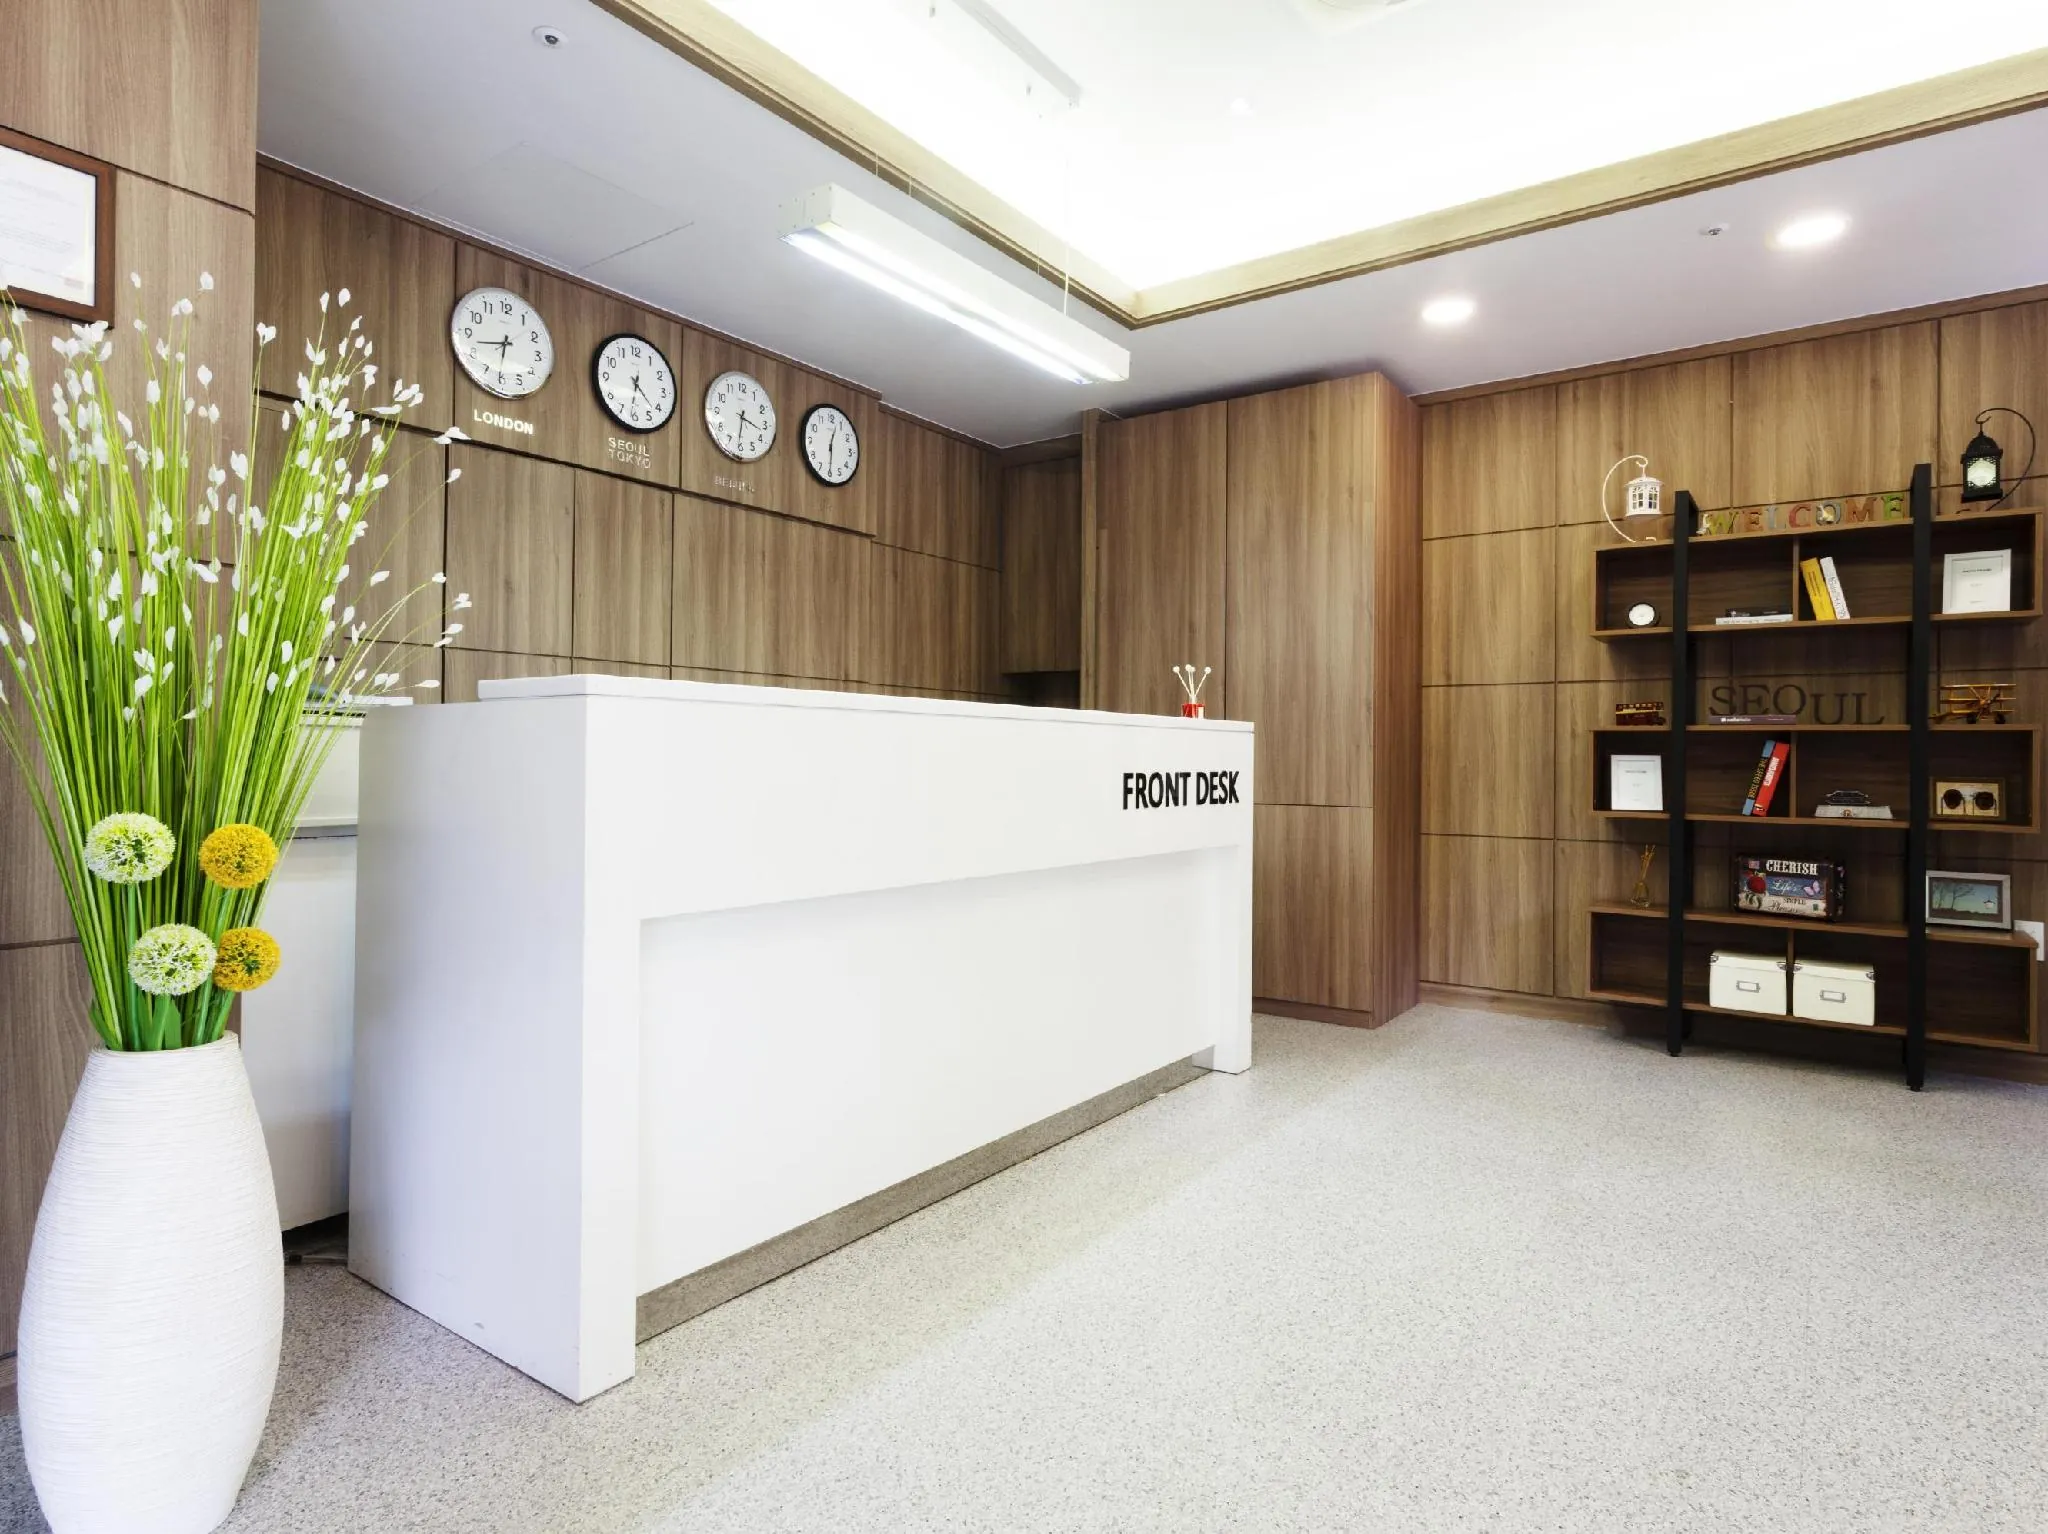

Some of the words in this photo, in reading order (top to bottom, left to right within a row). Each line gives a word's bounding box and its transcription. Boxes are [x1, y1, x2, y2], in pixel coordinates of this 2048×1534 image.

[473, 408, 535, 435] LONDON
[608, 437, 650, 457] SEOUL
[1706, 492, 1905, 535] WELCOME
[1709, 684, 1885, 725] SEOUL
[1123, 771, 1191, 810] FRONT
[1196, 770, 1239, 805] DESK
[1765, 860, 1819, 876] CHERISH
